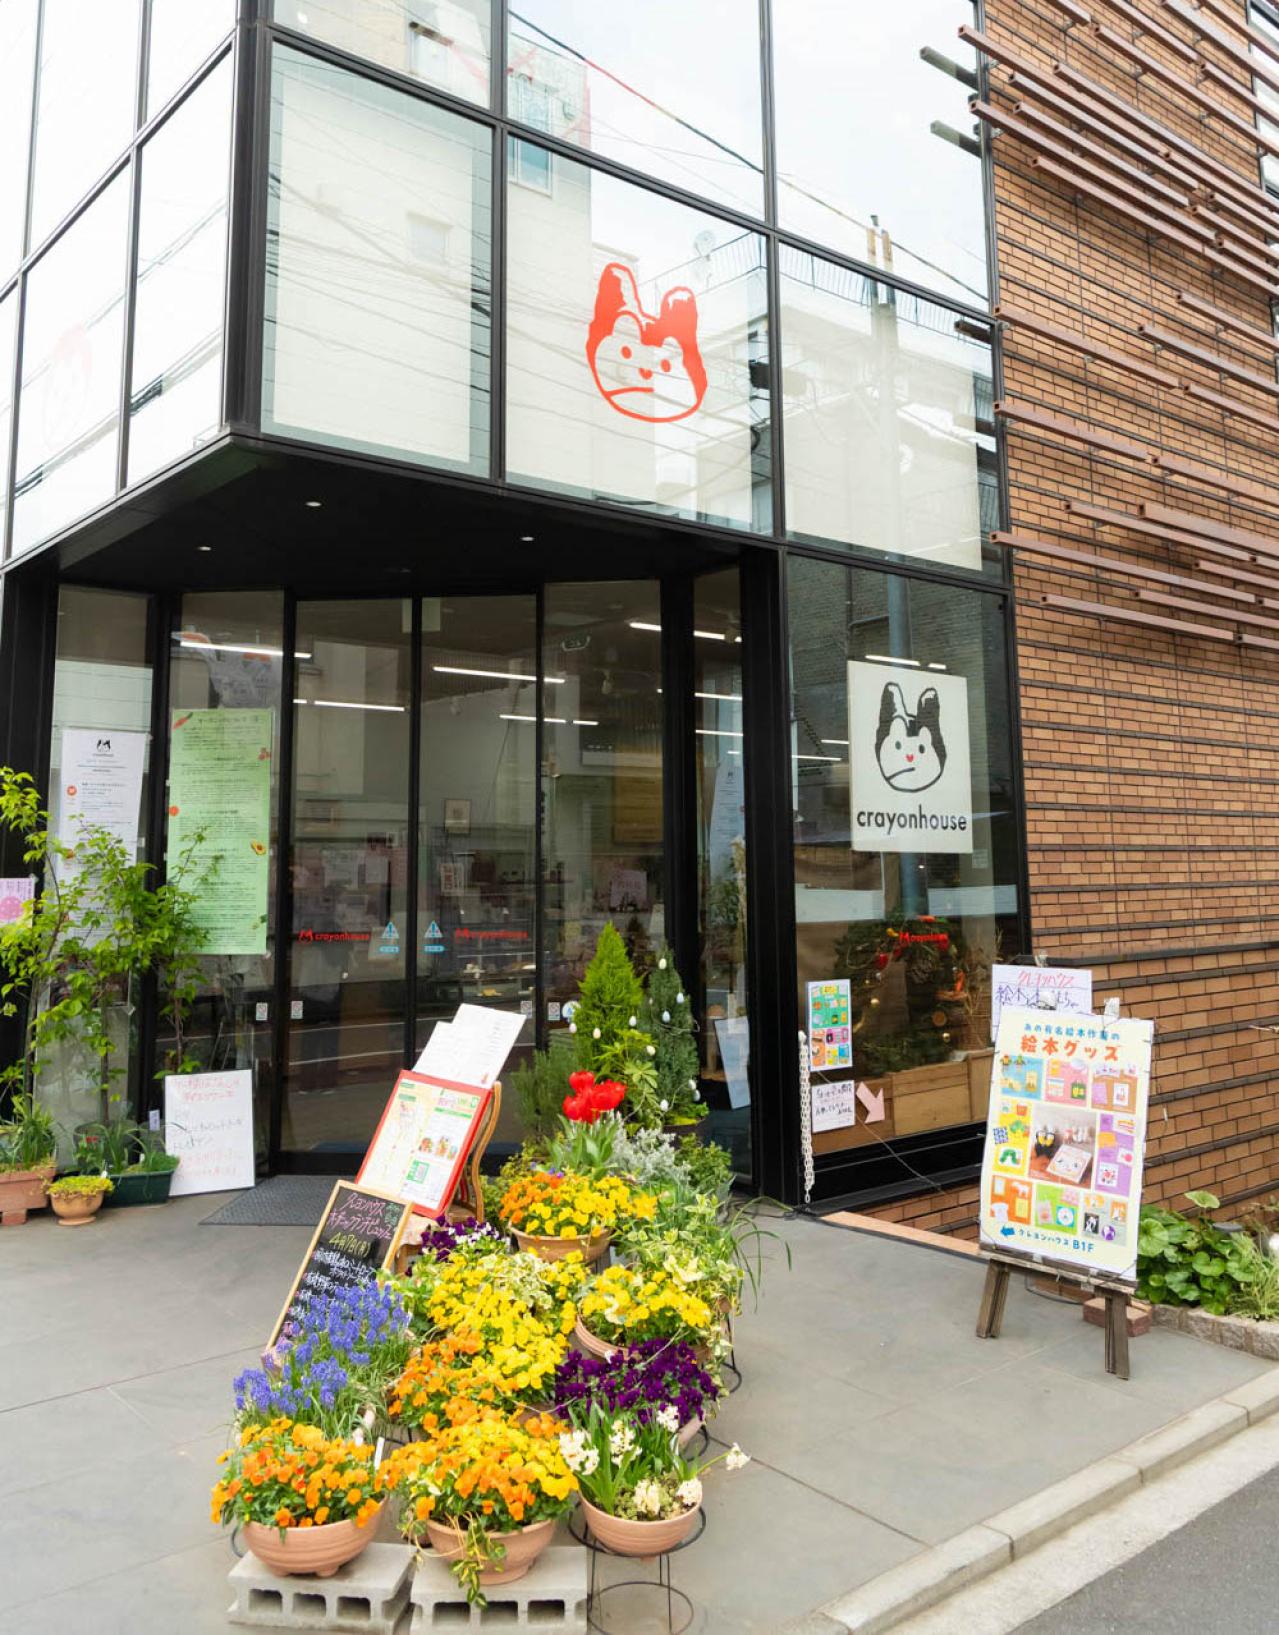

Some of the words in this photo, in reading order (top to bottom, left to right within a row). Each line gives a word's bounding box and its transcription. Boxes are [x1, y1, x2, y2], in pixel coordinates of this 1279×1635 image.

[856, 803, 967, 835] crayonhouse
[1020, 1035, 1120, 1061] 絵本グッズ
[1072, 1239, 1095, 1253] B1F
